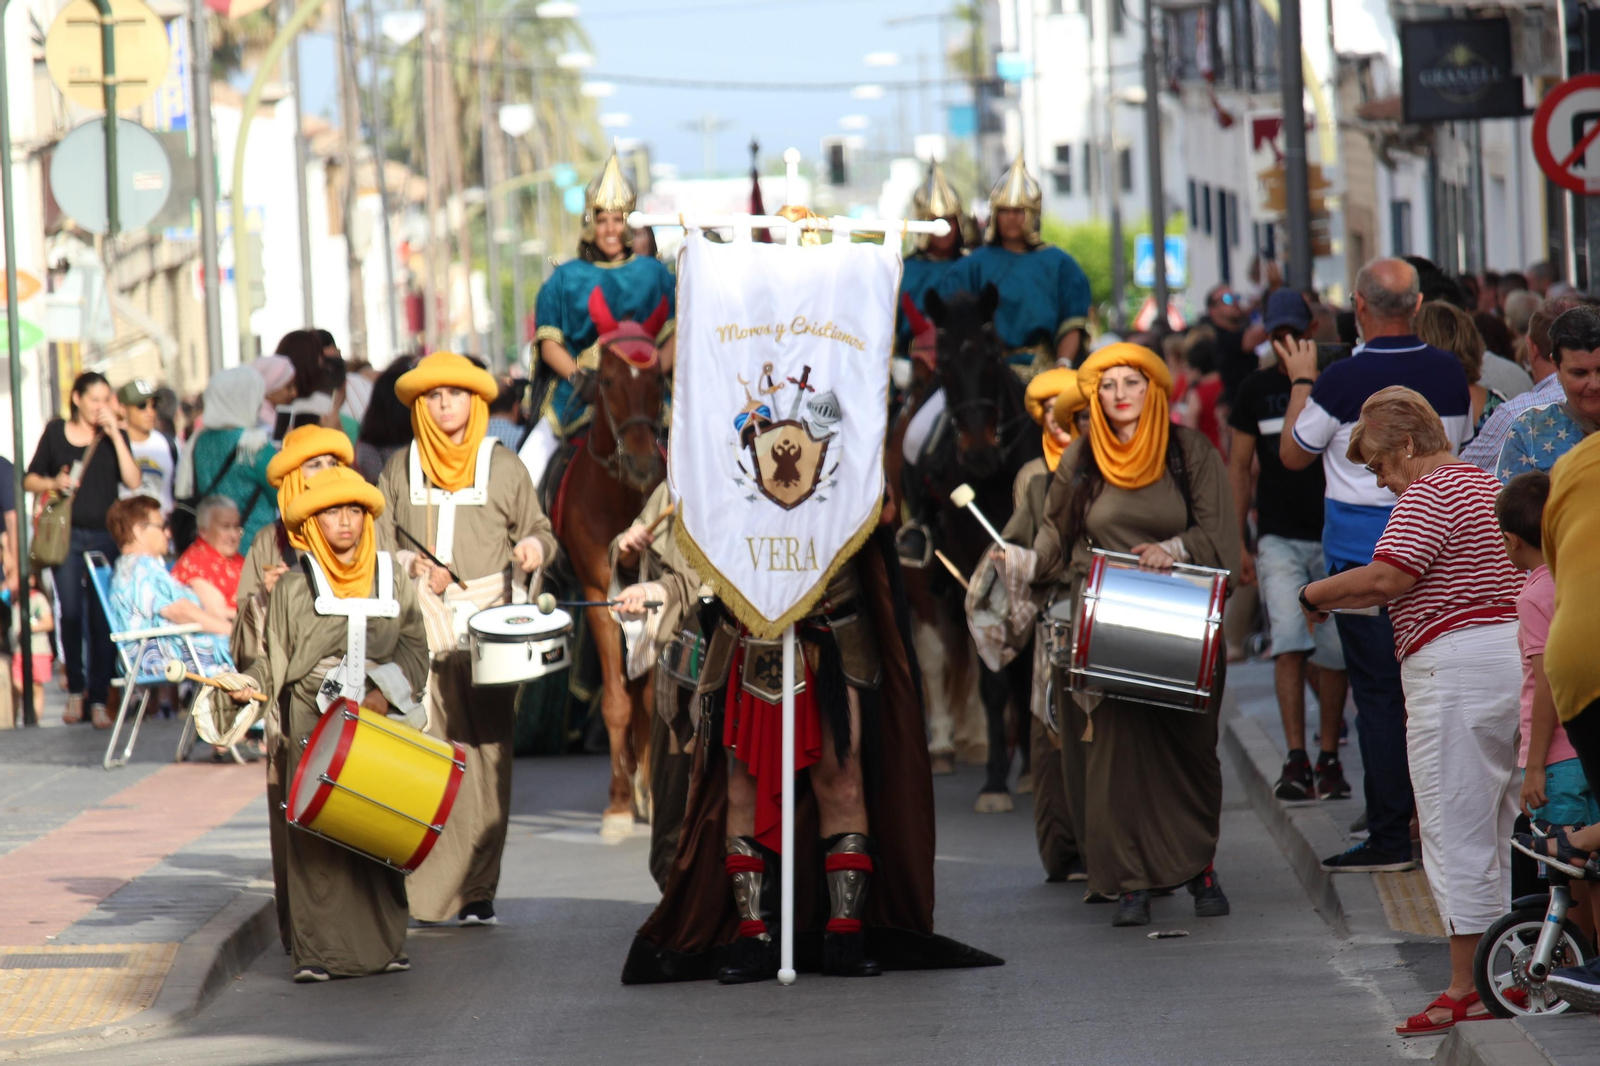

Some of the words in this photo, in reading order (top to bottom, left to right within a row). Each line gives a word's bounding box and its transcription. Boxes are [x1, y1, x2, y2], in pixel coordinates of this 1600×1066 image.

[716, 322, 771, 343] Moros
[775, 323, 786, 343] y
[790, 315, 866, 351] Cristianos
[745, 536, 819, 572] VERA
